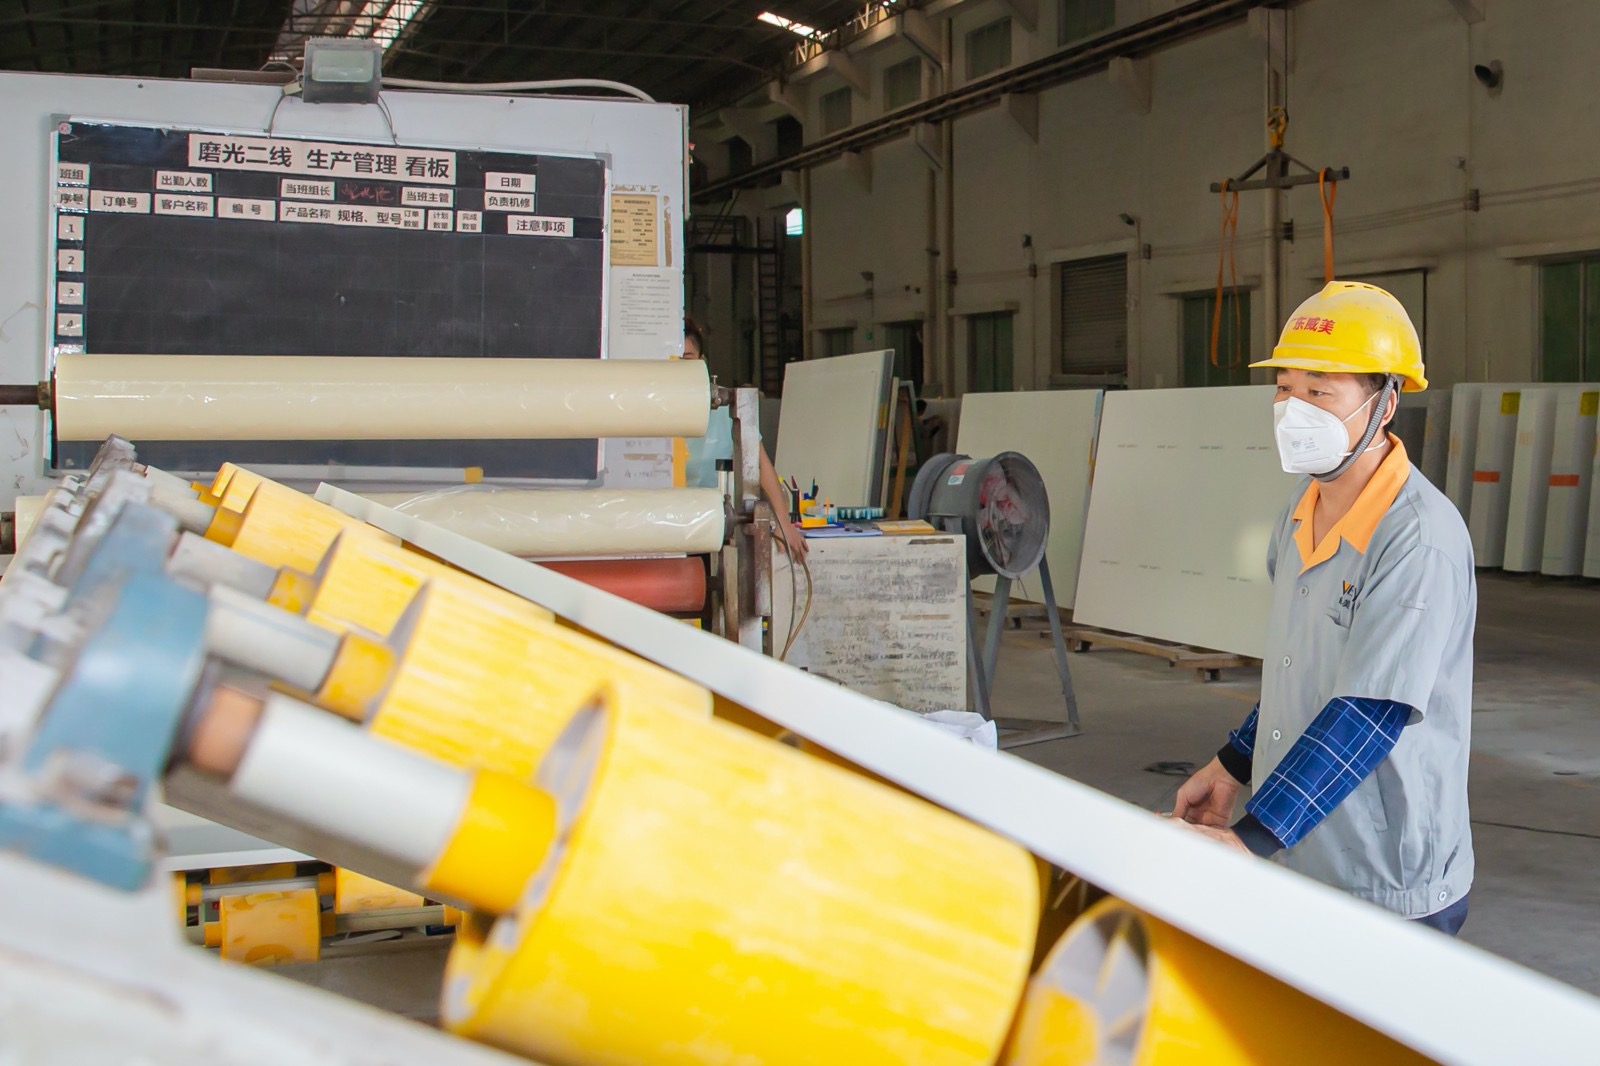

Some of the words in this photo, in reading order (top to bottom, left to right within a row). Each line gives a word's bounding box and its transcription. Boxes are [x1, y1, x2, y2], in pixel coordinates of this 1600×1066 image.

[198, 141, 292, 168] 磨光二线
[306, 149, 398, 175] 生产管理
[404, 155, 450, 178] 看板
[59, 168, 84, 180] 班组
[161, 175, 208, 188] 出勤人数
[500, 177, 522, 189] 日期
[286, 183, 332, 197] 当班组长
[59, 193, 84, 206] 序号
[102, 196, 139, 209] 订单号
[406, 190, 450, 204] 当班主管
[488, 196, 531, 209] 负责机修
[161, 199, 208, 212] 客户名称
[285, 206, 332, 220] 产品名称
[68, 224, 75, 233] 1
[516, 219, 566, 233] 注意事项
[68, 256, 75, 265] 2
